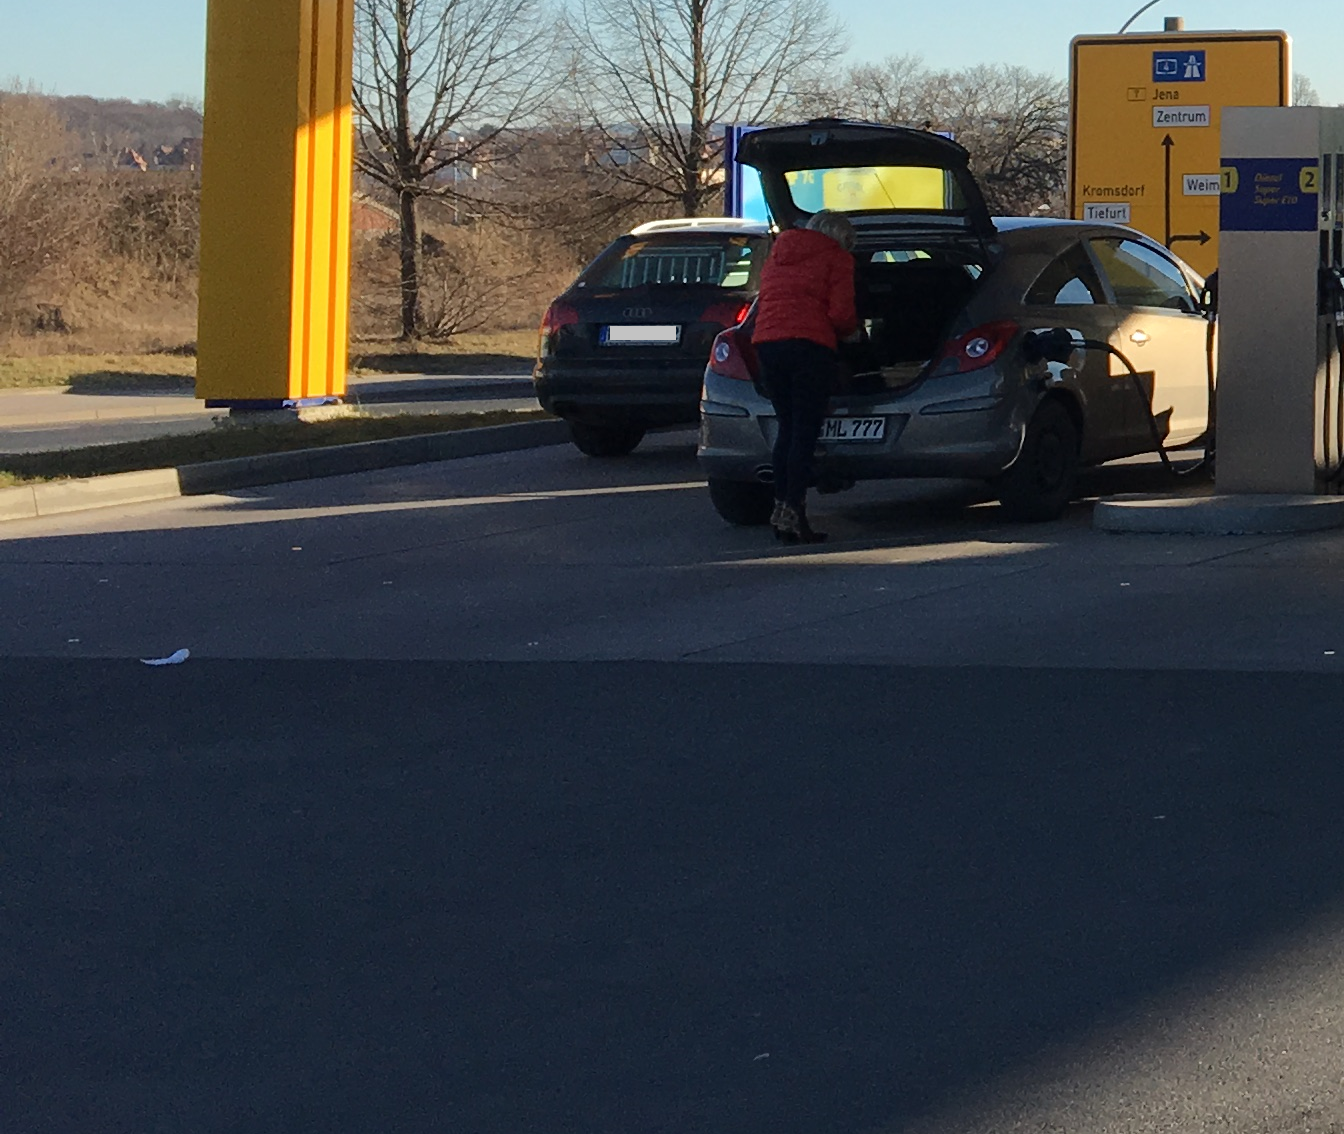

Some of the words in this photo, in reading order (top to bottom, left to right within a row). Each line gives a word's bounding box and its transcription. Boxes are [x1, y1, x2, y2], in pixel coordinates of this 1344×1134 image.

[1152, 88, 1180, 100] Jena
[1156, 110, 1207, 123] Zentrum
[1224, 171, 1231, 188] 1
[1304, 171, 1315, 188] 2
[1082, 184, 1146, 197] Kromsdorf
[1087, 206, 1127, 220] Tiefurt
[852, 419, 883, 437] 777
